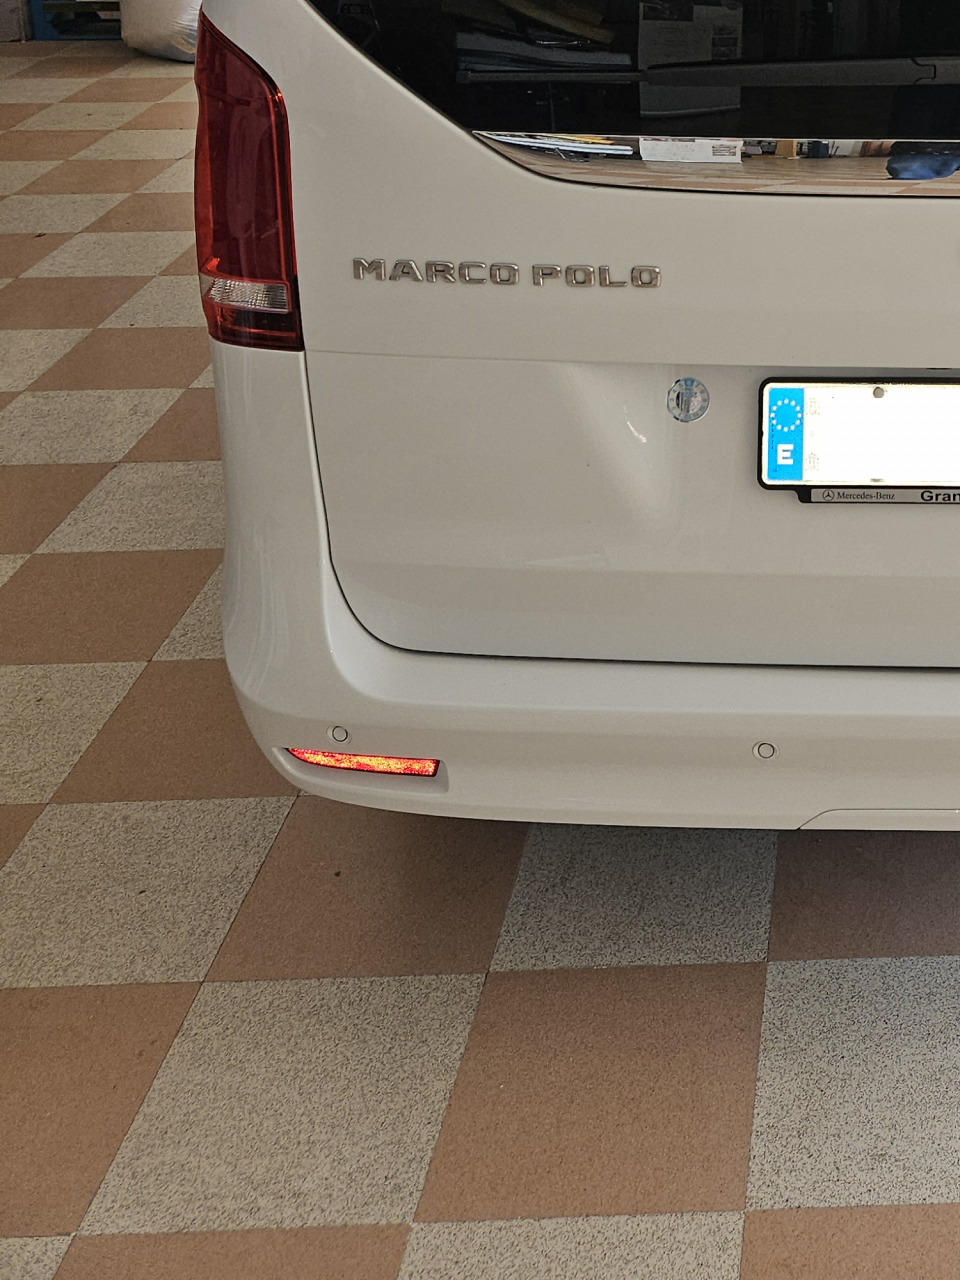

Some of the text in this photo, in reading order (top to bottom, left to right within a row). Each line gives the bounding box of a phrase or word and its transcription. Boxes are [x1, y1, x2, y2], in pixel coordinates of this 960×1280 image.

[352, 257, 662, 288] MARCO POLO
[777, 443, 794, 465] E
[836, 491, 896, 500] Mercedes-Benz
